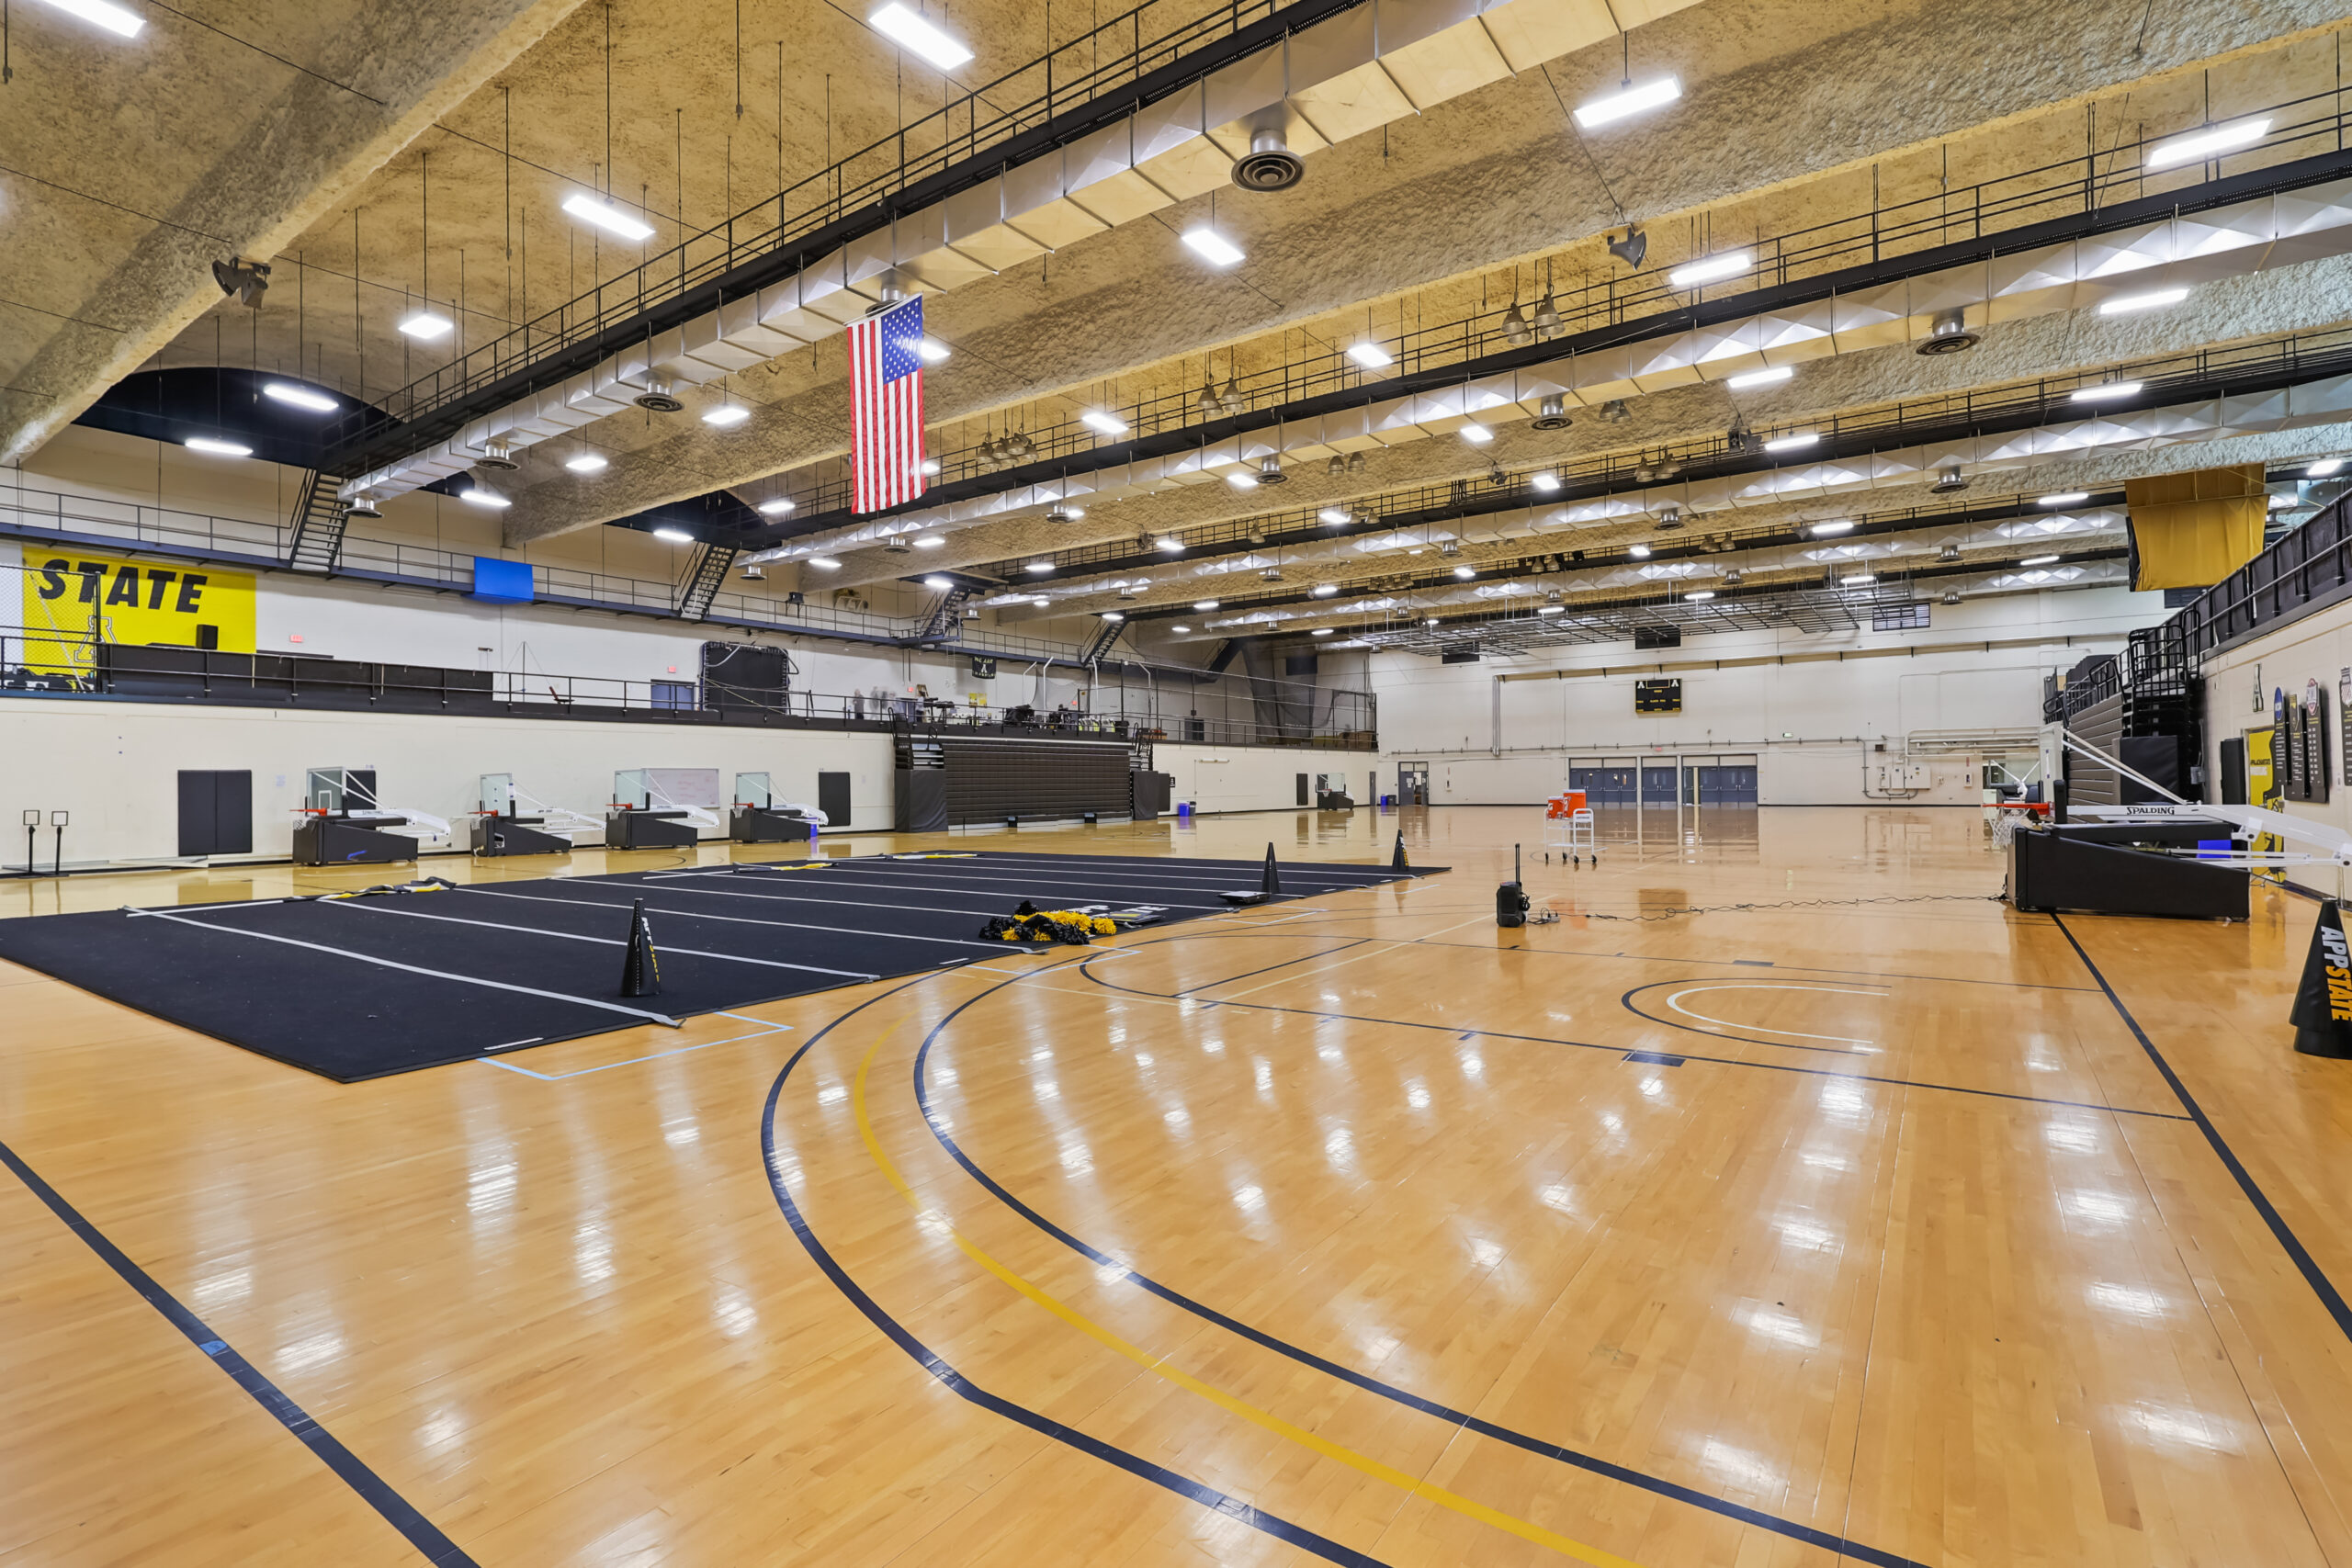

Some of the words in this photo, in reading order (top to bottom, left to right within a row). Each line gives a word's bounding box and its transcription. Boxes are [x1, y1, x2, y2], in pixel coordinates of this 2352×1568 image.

[39, 558, 208, 614] STATE
[2126, 807, 2175, 816] SPALDING
[2321, 925, 2348, 968] APP
[2325, 965, 2352, 1021] STATE
